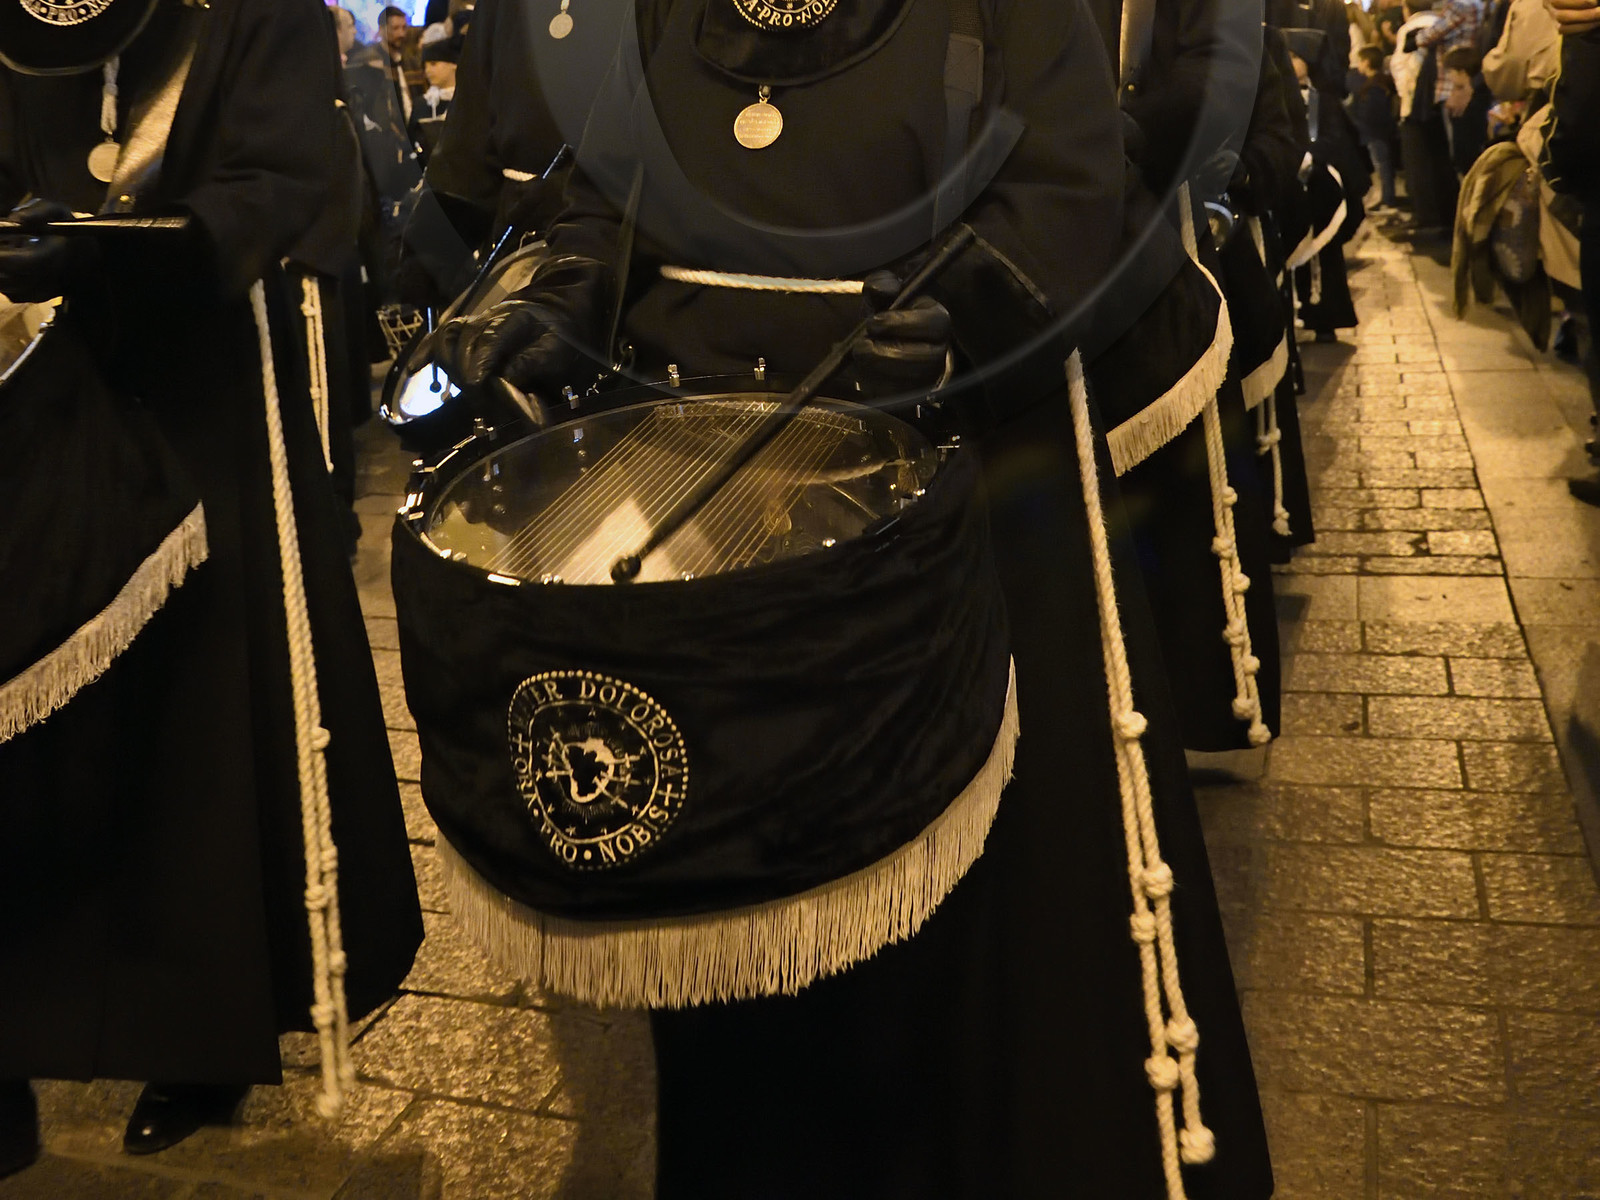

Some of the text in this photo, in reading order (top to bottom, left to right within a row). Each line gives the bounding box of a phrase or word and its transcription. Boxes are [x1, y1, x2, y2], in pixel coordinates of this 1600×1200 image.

[46, 7, 78, 22] PRO
[757, 6, 793, 27] PRO
[579, 679, 682, 779] DOLOROSA
[598, 805, 669, 863] NOBIS
